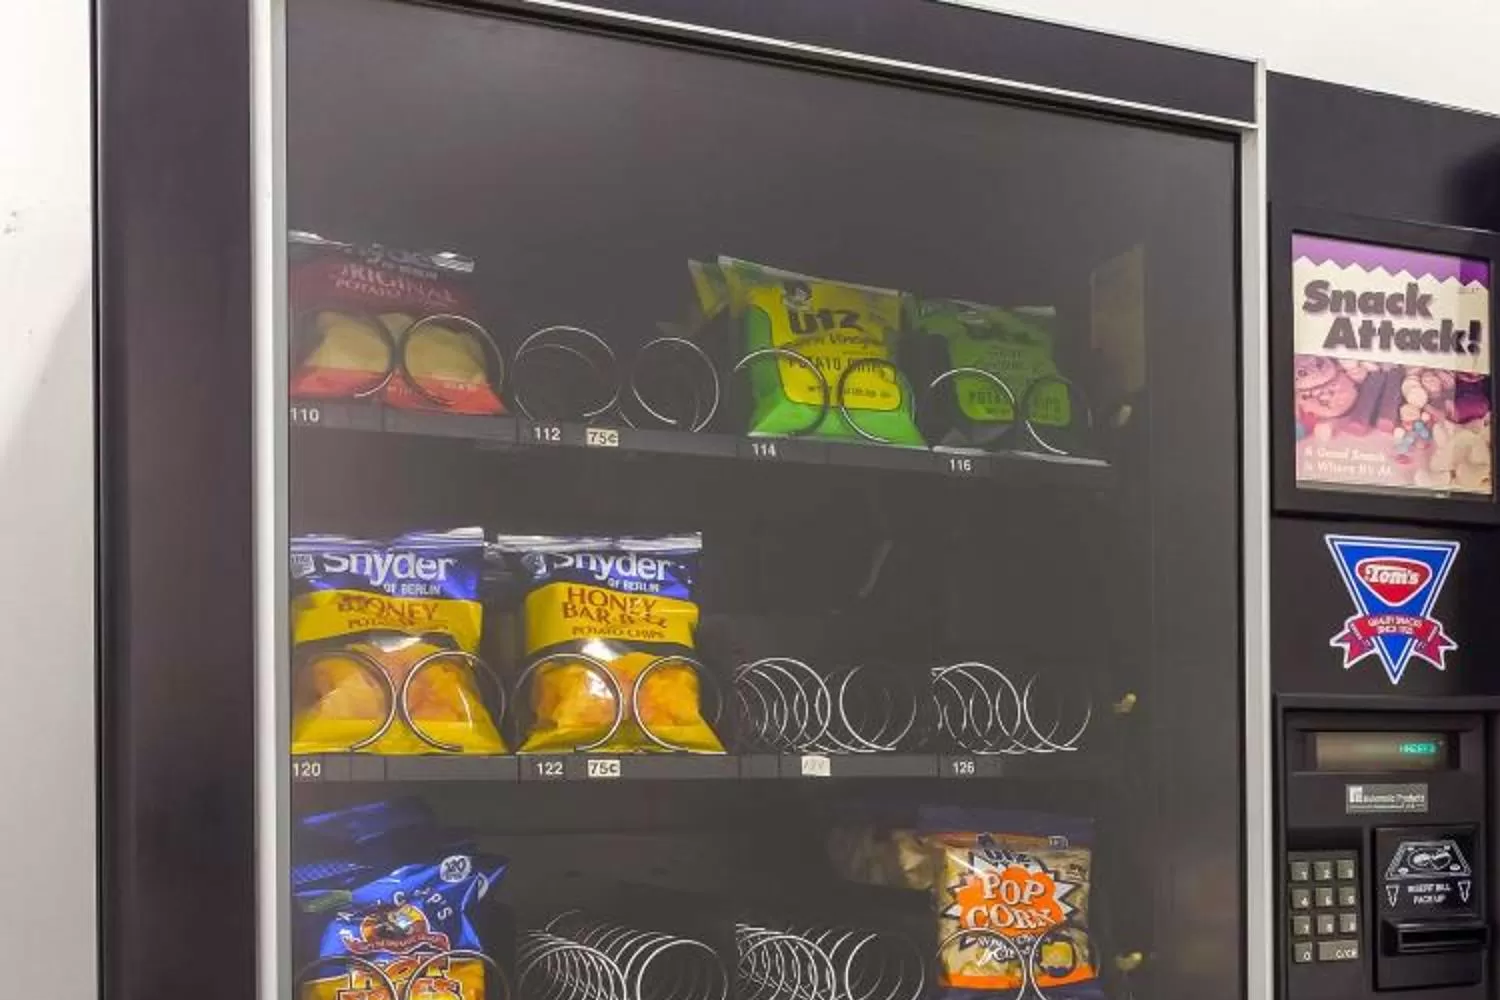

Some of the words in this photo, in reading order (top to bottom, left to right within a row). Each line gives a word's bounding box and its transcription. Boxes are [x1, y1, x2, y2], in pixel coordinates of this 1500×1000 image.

[1302, 279, 1433, 318] Snack
[1322, 316, 1483, 356] Attack!
[290, 407, 320, 423] 110
[534, 426, 562, 442] 112
[751, 443, 777, 459] 114
[949, 458, 972, 473] 116
[324, 549, 456, 584] Snyder
[552, 550, 675, 581] Snyder
[1364, 564, 1421, 585] Tom's
[566, 586, 658, 613] HONEY
[292, 762, 322, 777] 120
[536, 761, 564, 776] 122
[952, 761, 976, 775] 126
[980, 869, 1046, 905] POP
[966, 903, 1056, 929] CORN
